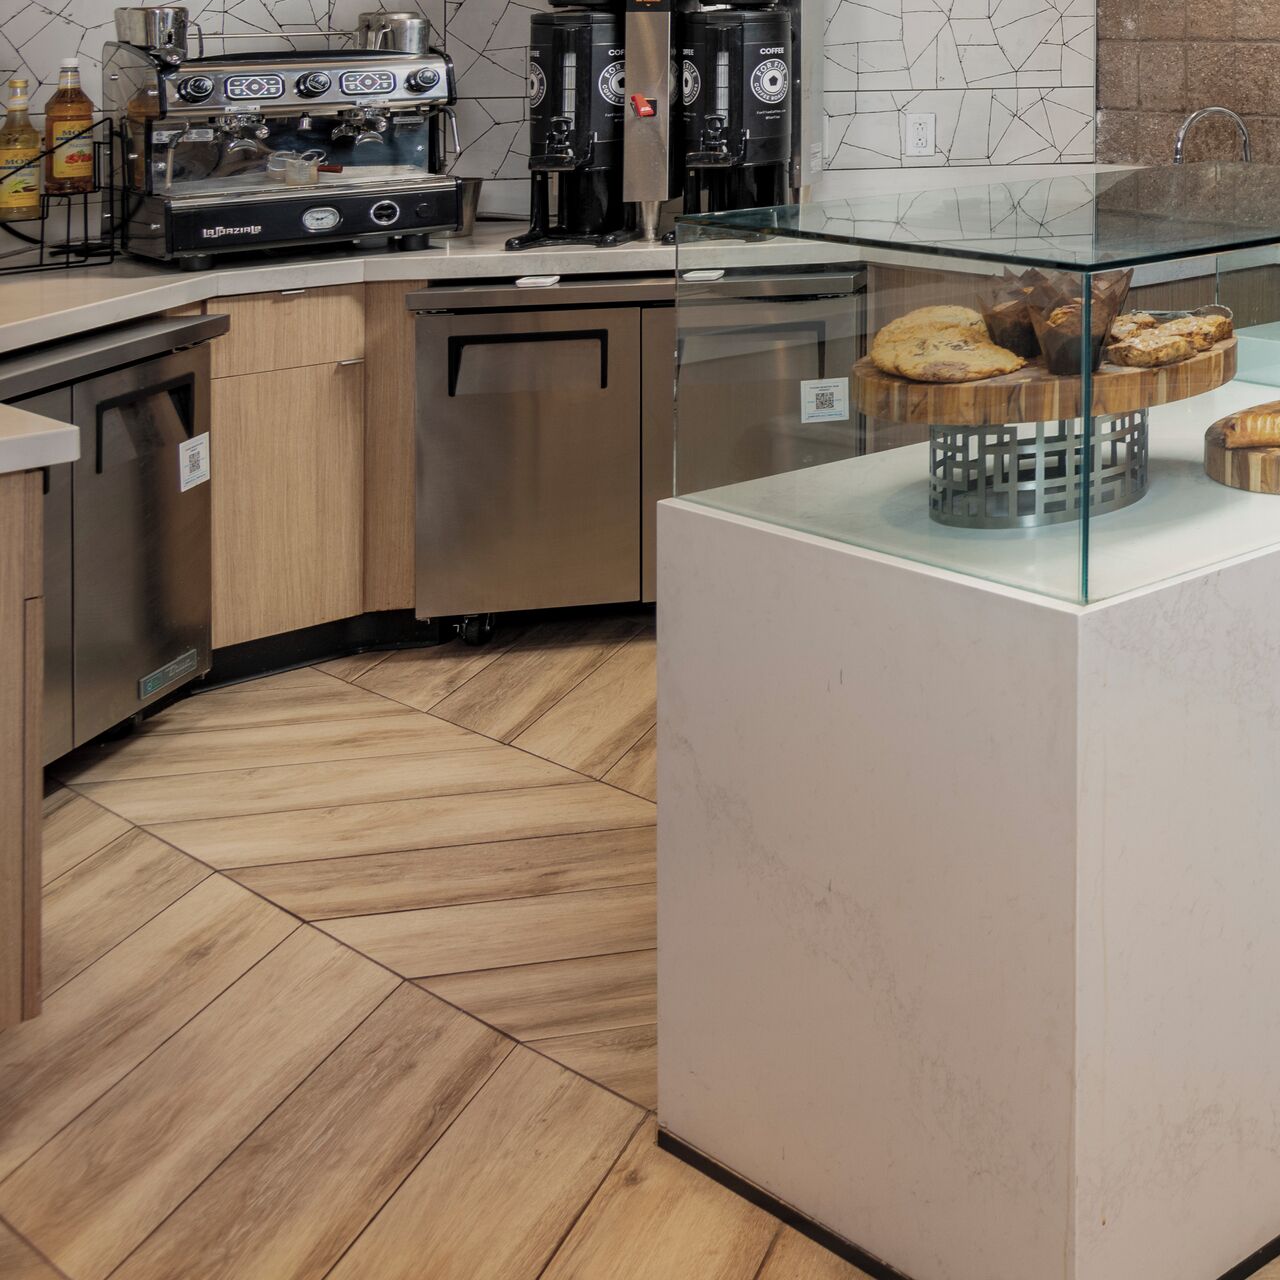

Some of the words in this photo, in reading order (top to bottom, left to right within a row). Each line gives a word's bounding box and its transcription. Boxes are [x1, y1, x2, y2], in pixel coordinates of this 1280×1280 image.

[760, 47, 785, 55] COFFEE
[756, 62, 773, 77] FOR
[774, 61, 789, 74] FIVE
[754, 82, 771, 101] COFFEE
